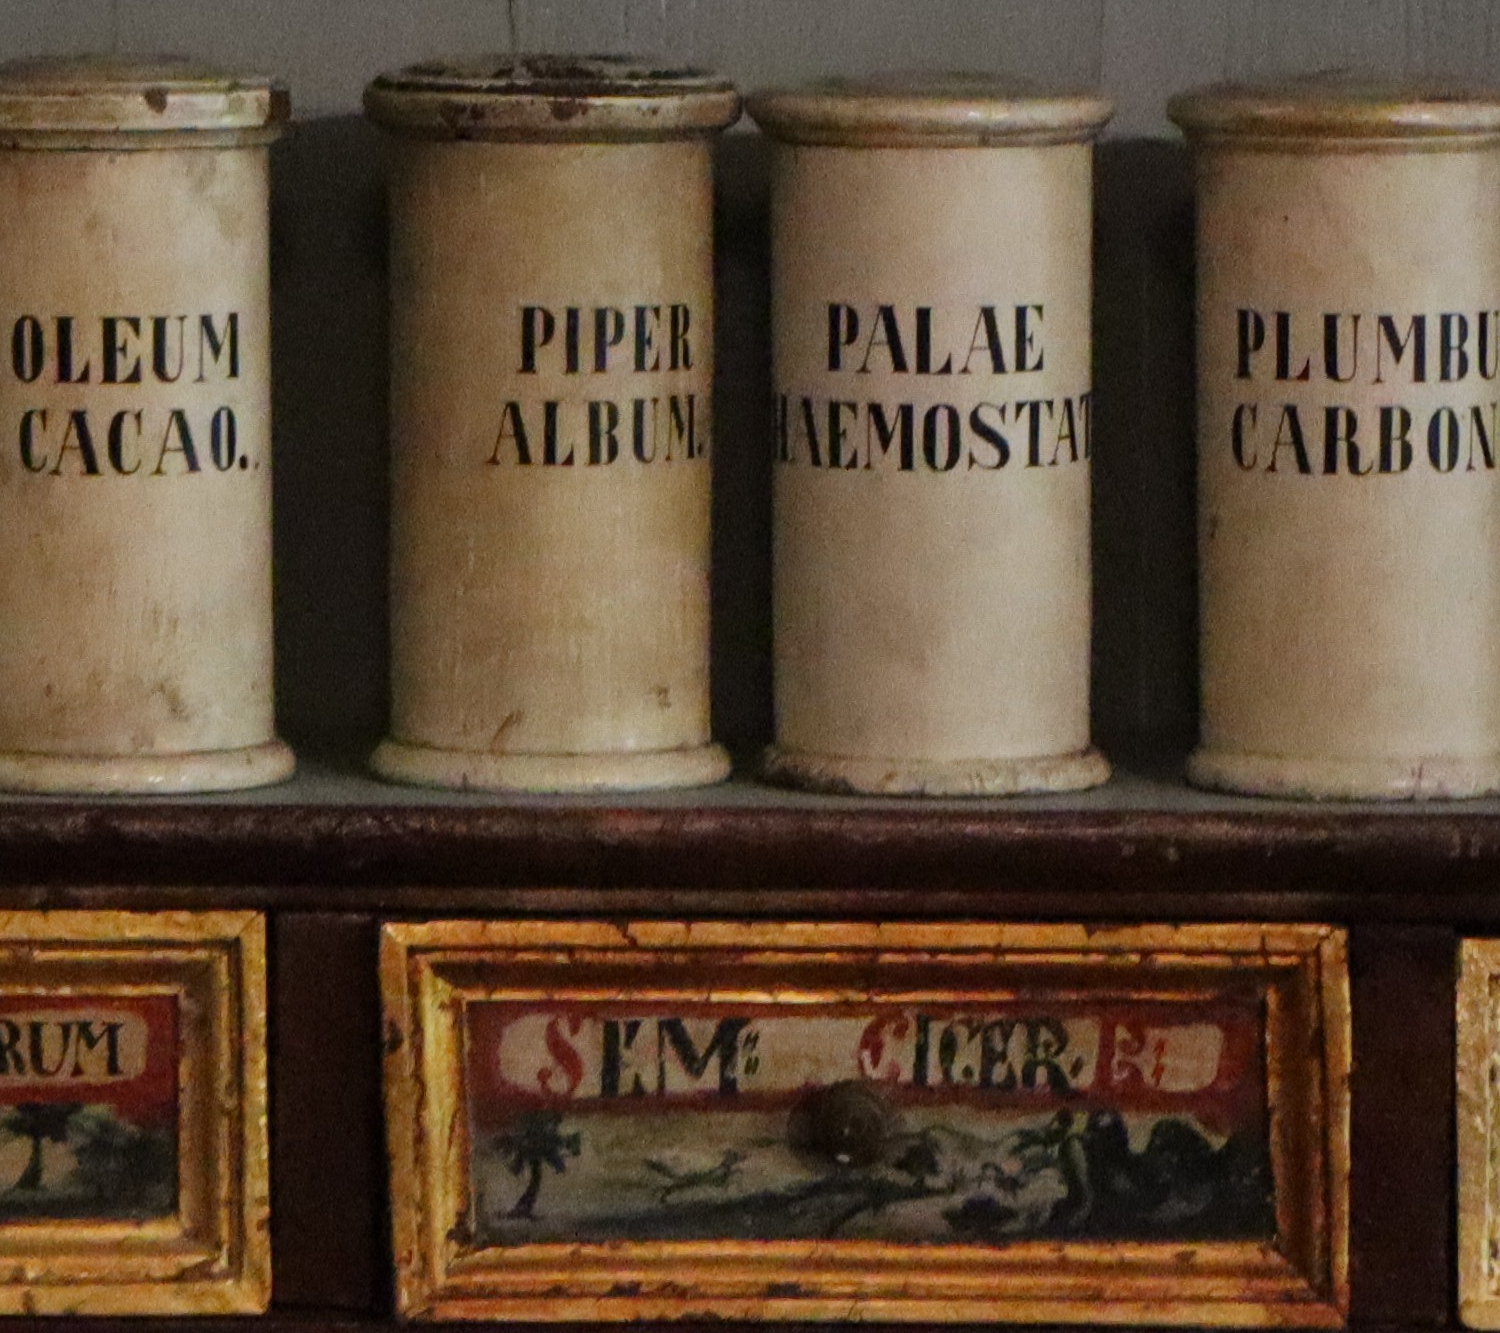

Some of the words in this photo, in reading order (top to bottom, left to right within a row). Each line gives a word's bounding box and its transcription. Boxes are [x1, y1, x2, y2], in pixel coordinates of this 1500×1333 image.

[11, 313, 240, 385] OLEUM
[518, 304, 694, 377] PIPER
[827, 304, 1044, 374] PALAE
[18, 405, 248, 475] CACAO.
